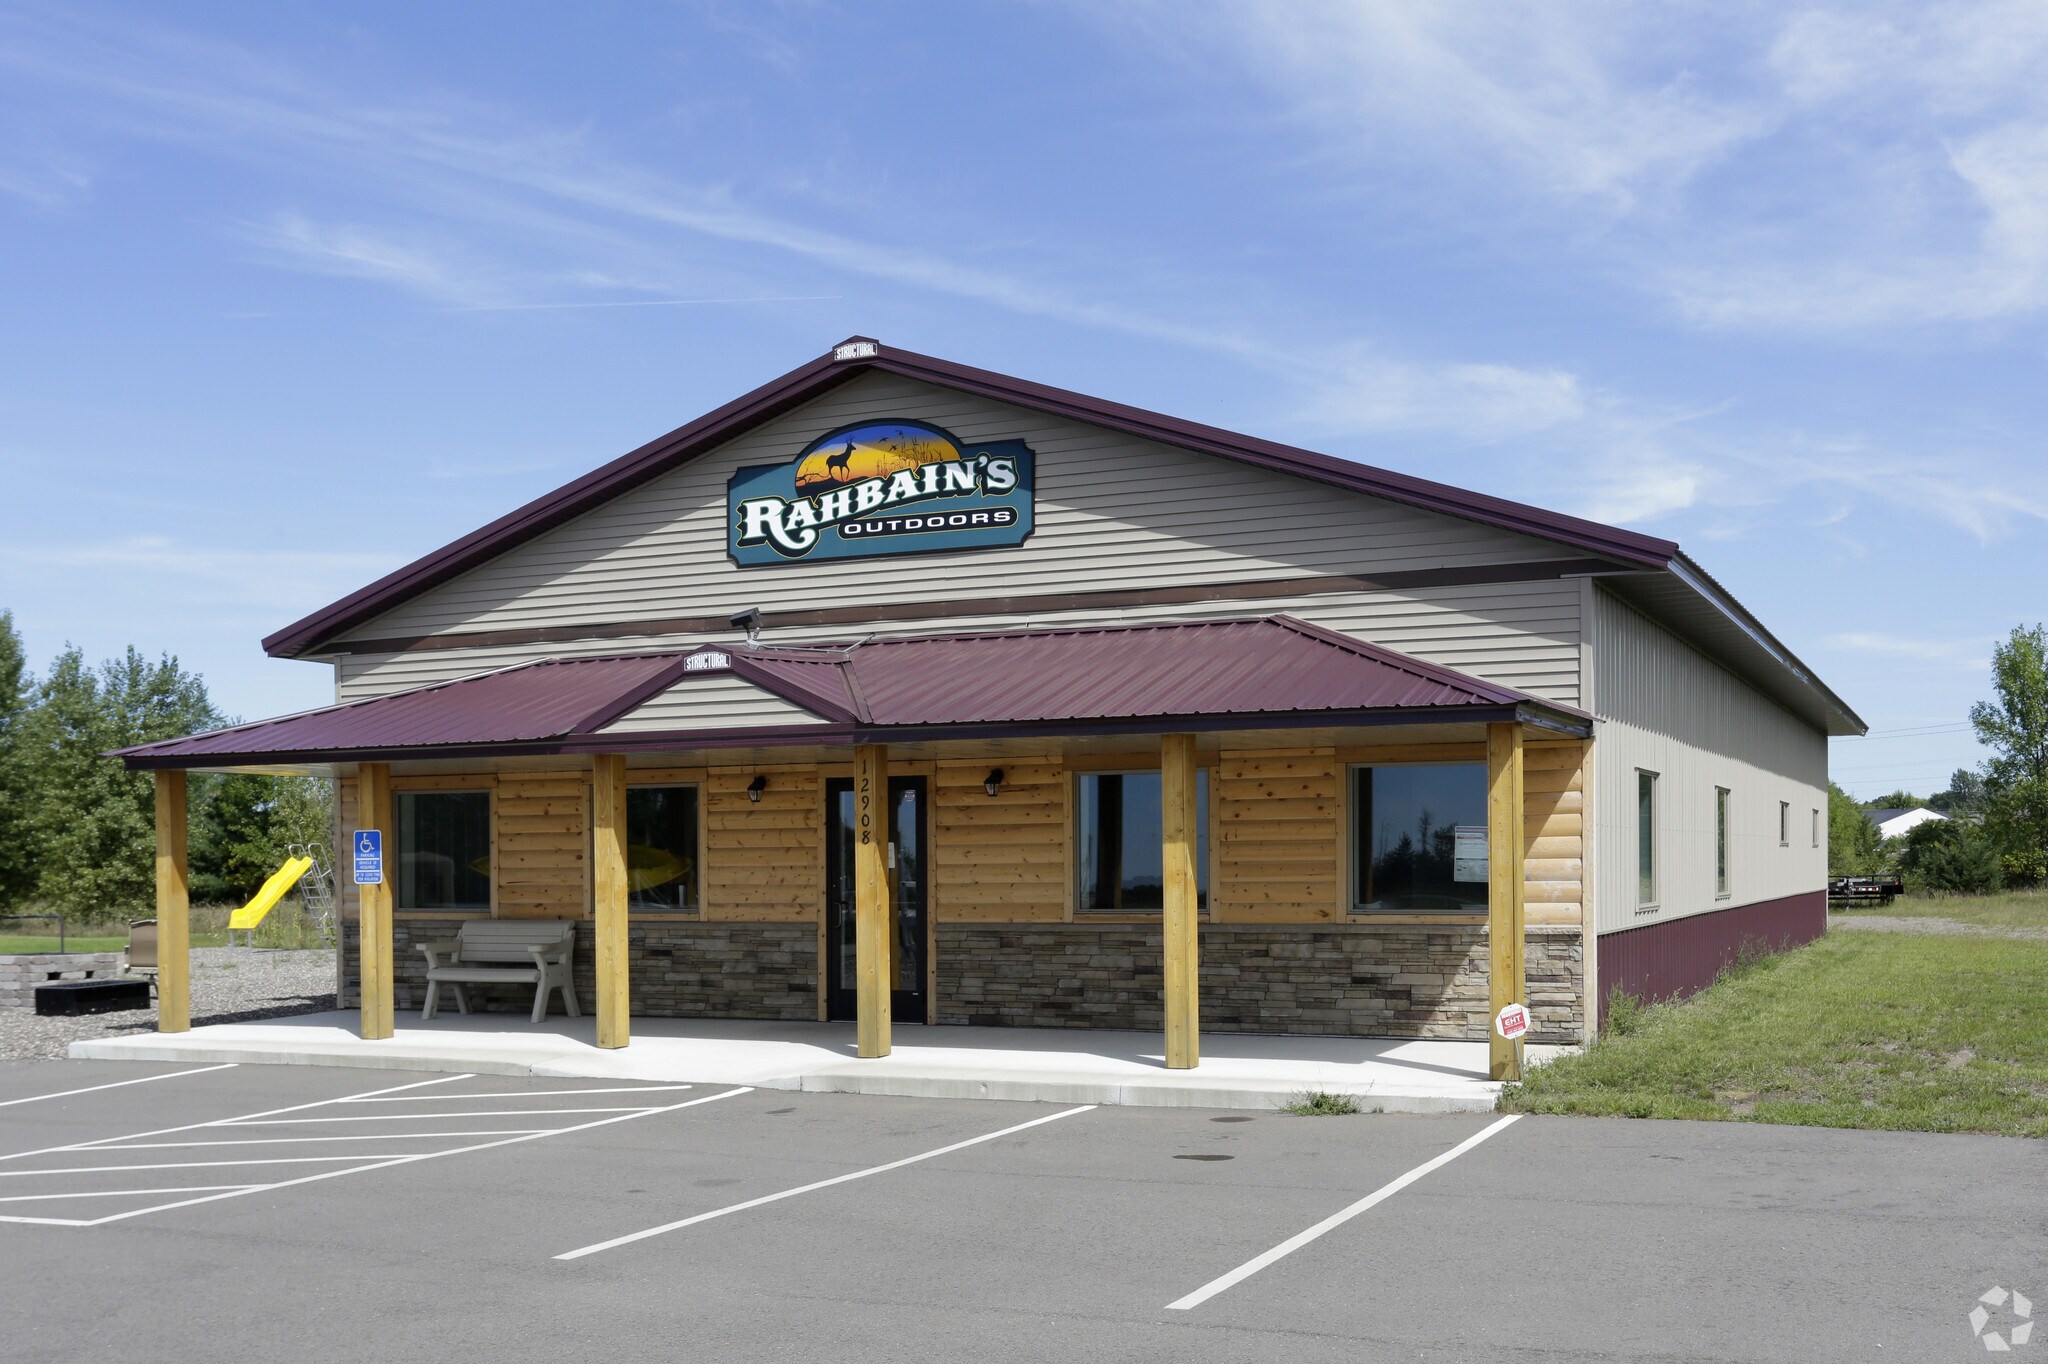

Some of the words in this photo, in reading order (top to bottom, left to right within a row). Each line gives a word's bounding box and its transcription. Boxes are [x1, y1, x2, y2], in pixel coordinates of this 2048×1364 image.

[836, 343, 876, 359] STRUCTURAL
[742, 456, 1017, 549] RAHBAIN'S
[843, 510, 1011, 535] OUTDOORS
[686, 653, 729, 670] STRUCTURAL
[861, 759, 871, 845] 12908
